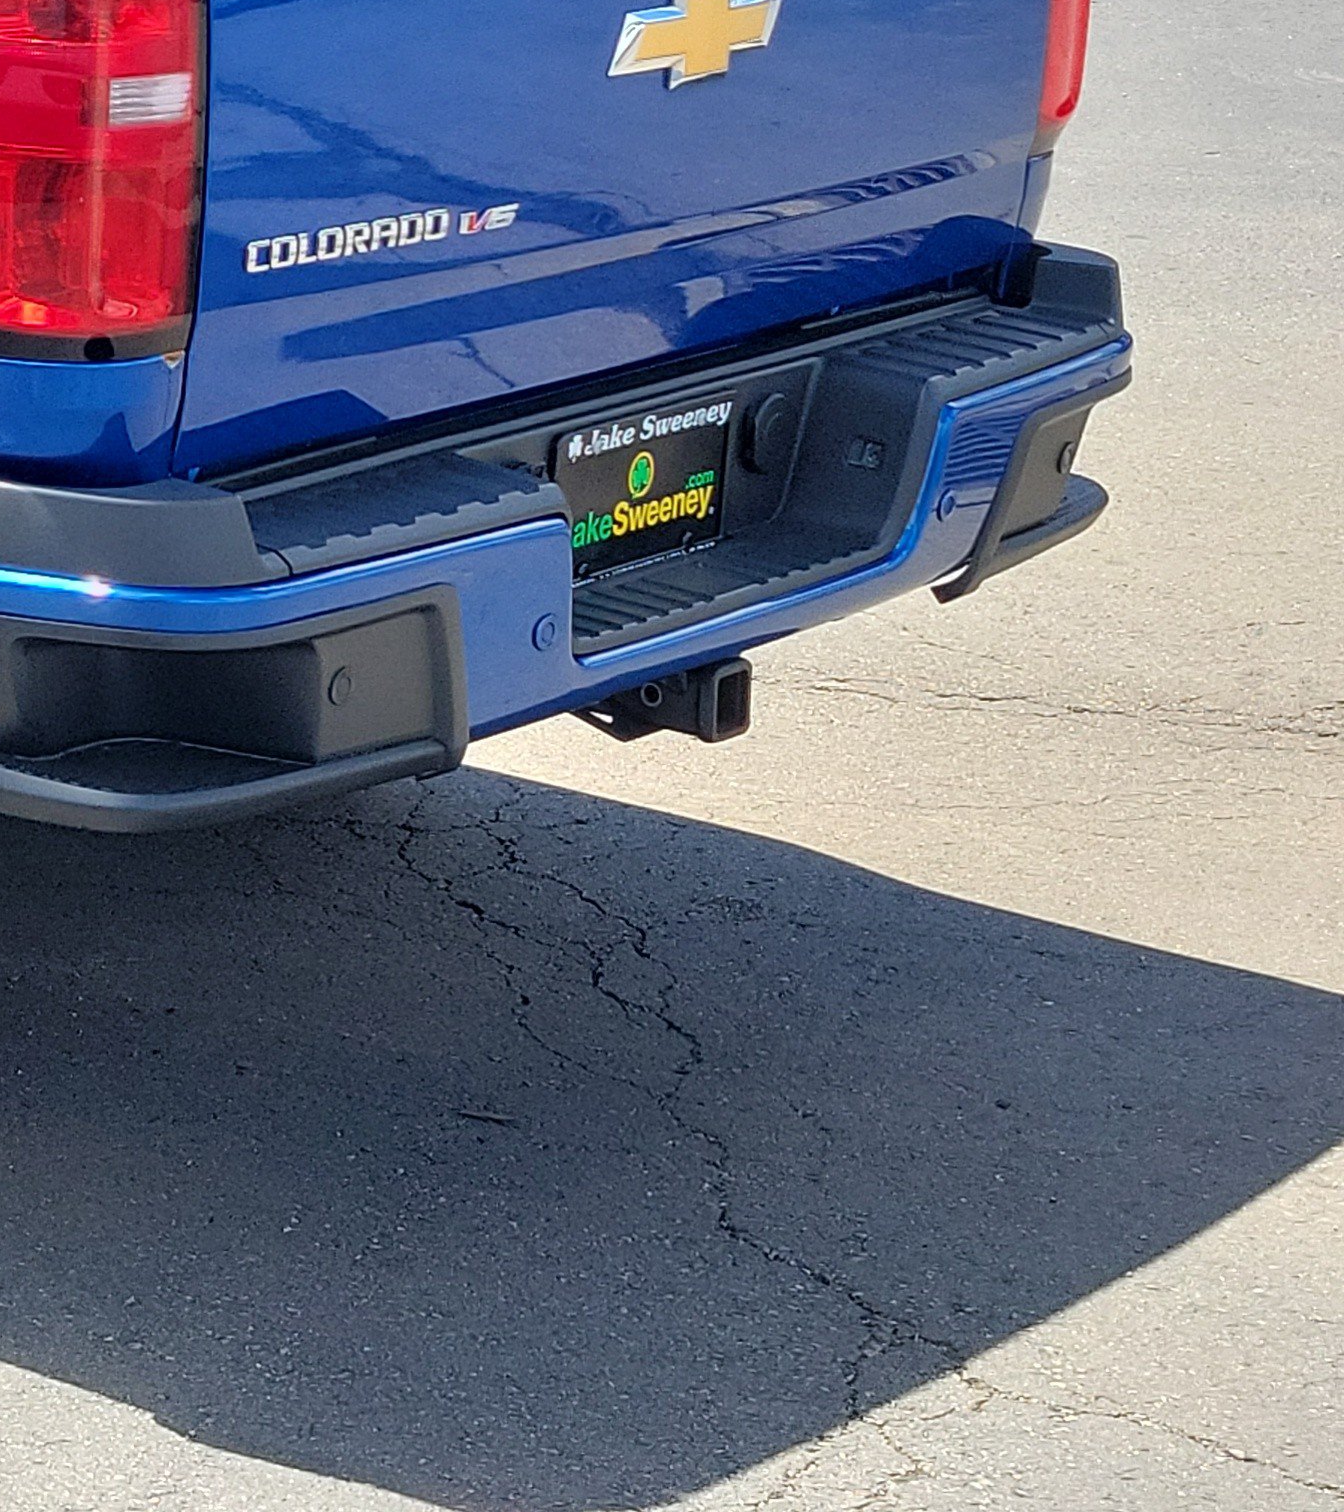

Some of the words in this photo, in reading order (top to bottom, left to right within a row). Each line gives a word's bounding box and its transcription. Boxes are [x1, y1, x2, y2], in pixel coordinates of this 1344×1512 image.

[245, 208, 449, 273] COLORADO
[458, 203, 520, 235] V6
[584, 424, 636, 456] Jake
[639, 401, 733, 440] Sweeney
[685, 469, 715, 489] .com
[572, 485, 714, 548] akeSweeney
